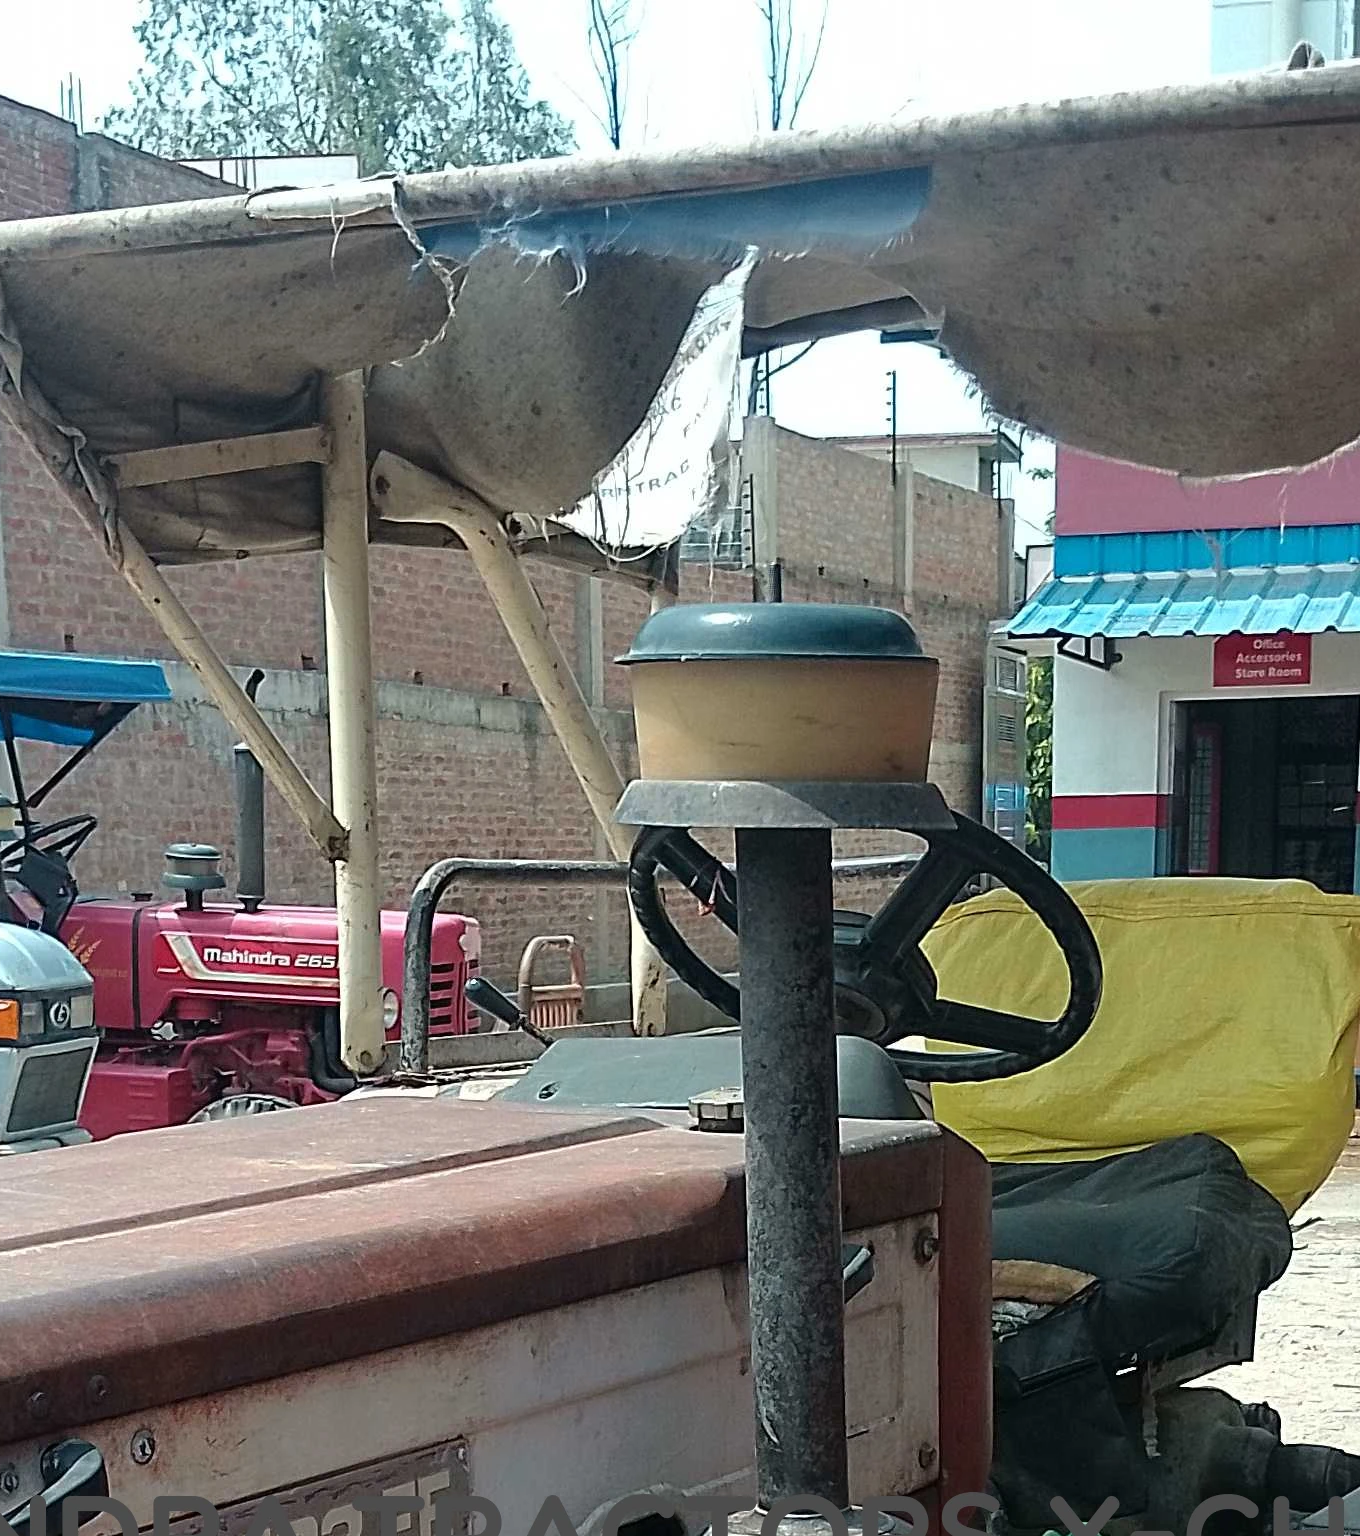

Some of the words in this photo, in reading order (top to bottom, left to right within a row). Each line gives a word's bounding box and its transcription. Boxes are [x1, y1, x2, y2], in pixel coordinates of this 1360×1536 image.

[1253, 639, 1286, 650] Office
[1235, 651, 1303, 664] Accessories
[1267, 666, 1302, 678] Room
[203, 947, 290, 966] Mahindra
